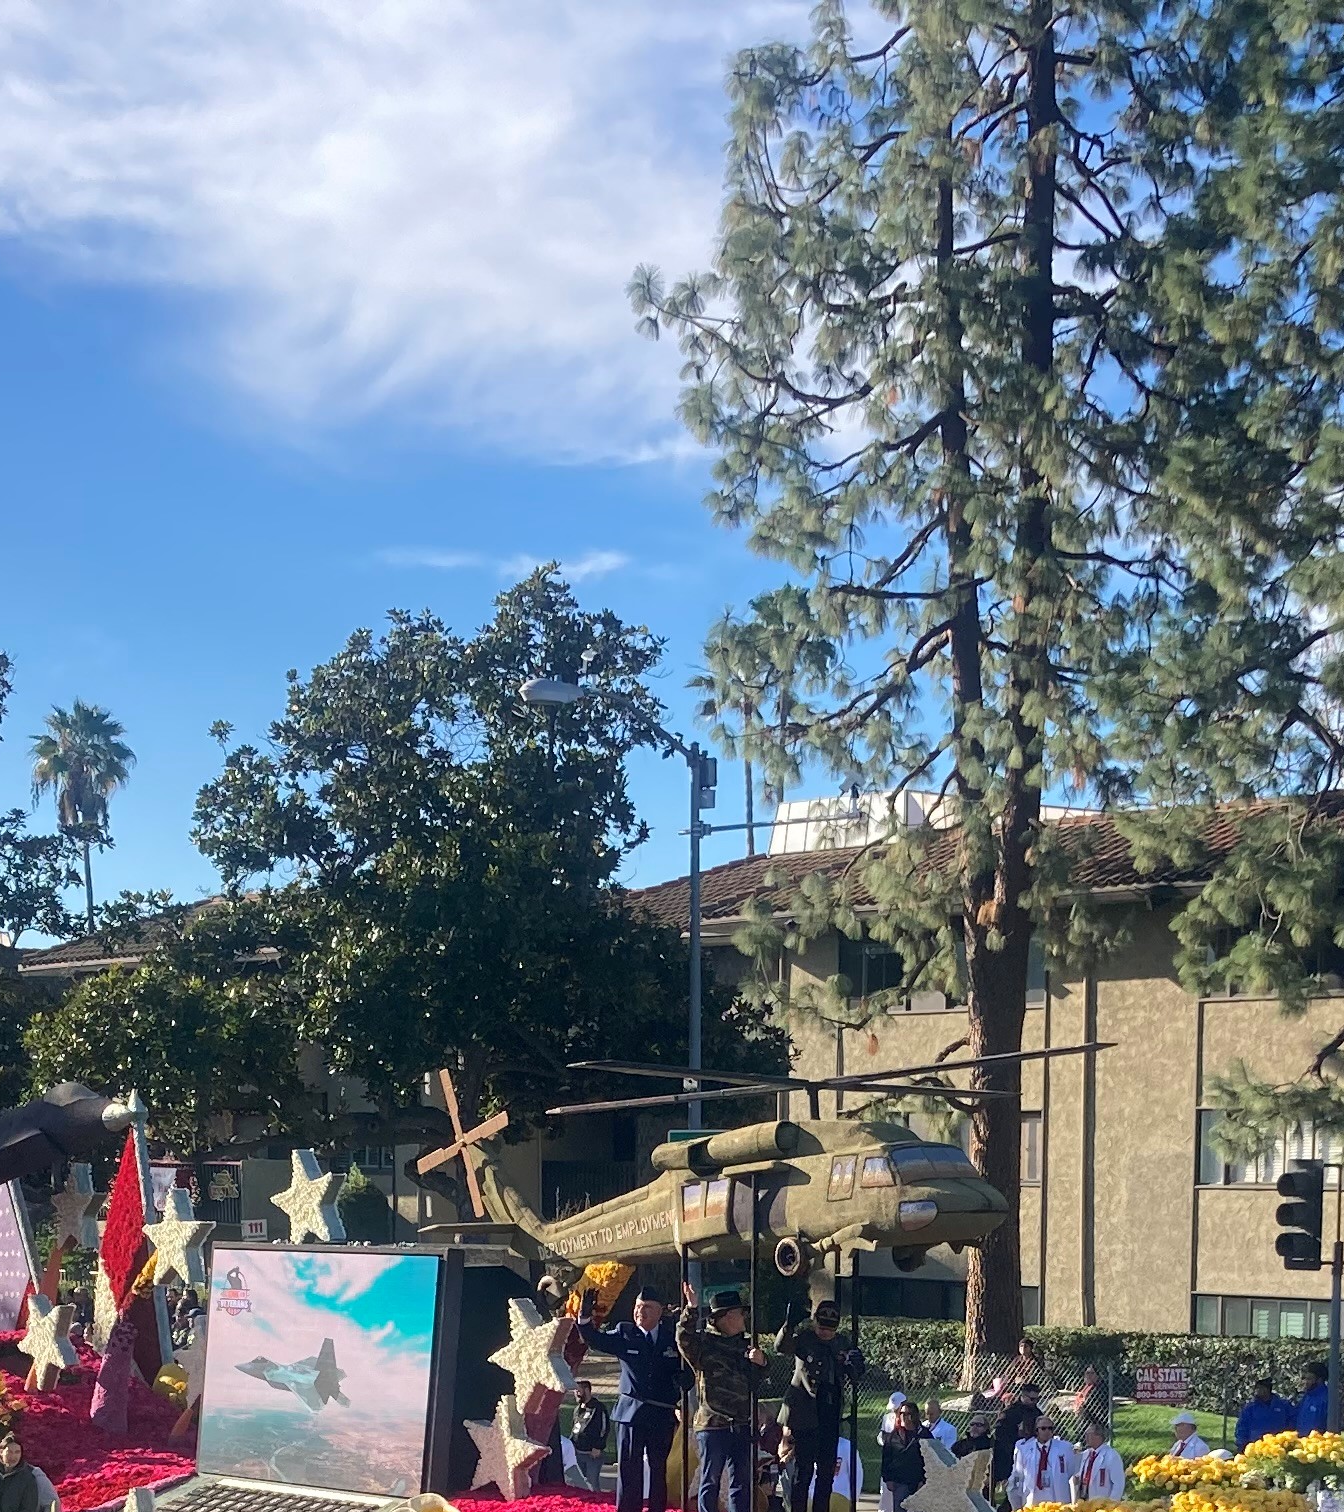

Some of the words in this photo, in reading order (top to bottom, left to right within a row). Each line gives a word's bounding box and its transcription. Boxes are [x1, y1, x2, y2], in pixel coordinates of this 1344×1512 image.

[248, 1222, 263, 1234] 111
[538, 1230, 598, 1261] DEPLOYMENT
[599, 1227, 613, 1244] TO
